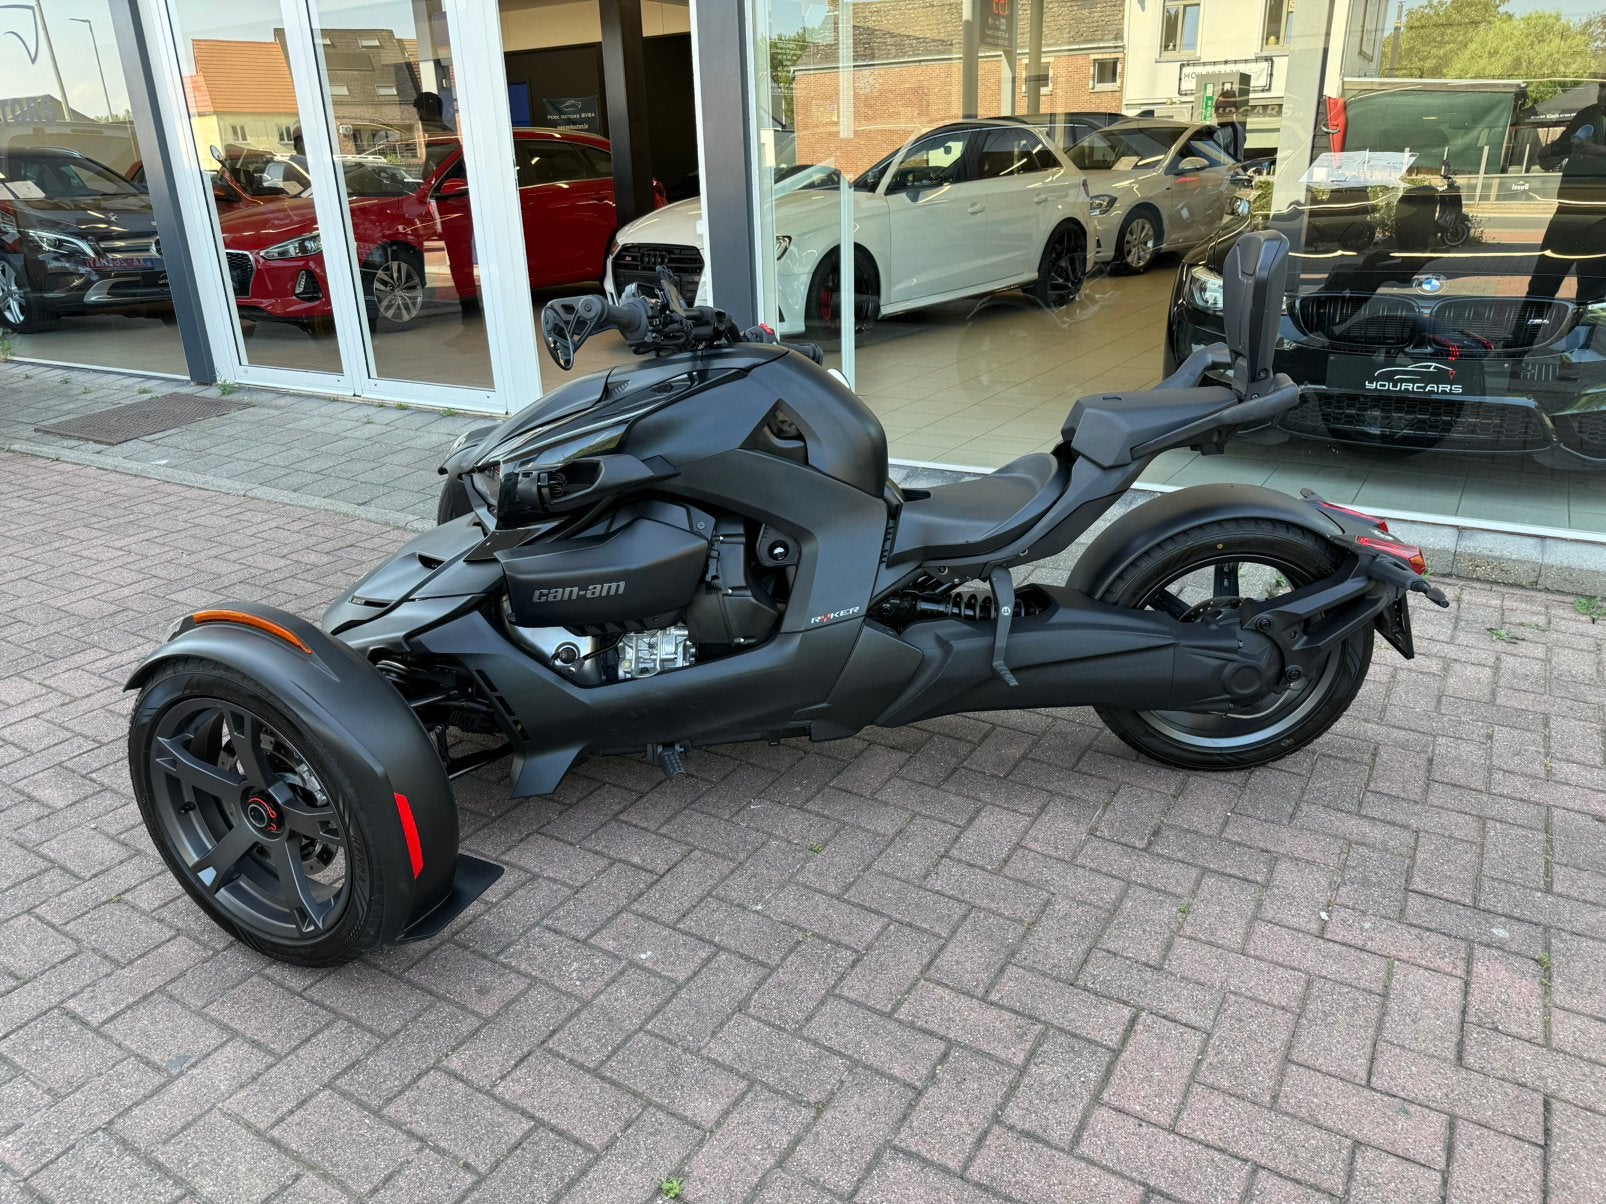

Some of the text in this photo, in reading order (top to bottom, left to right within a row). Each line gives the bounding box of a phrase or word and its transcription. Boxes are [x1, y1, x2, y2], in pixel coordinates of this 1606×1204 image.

[1365, 380, 1463, 393] YOURCARS
[532, 581, 625, 602] can-am
[811, 606, 859, 624] RYKER
